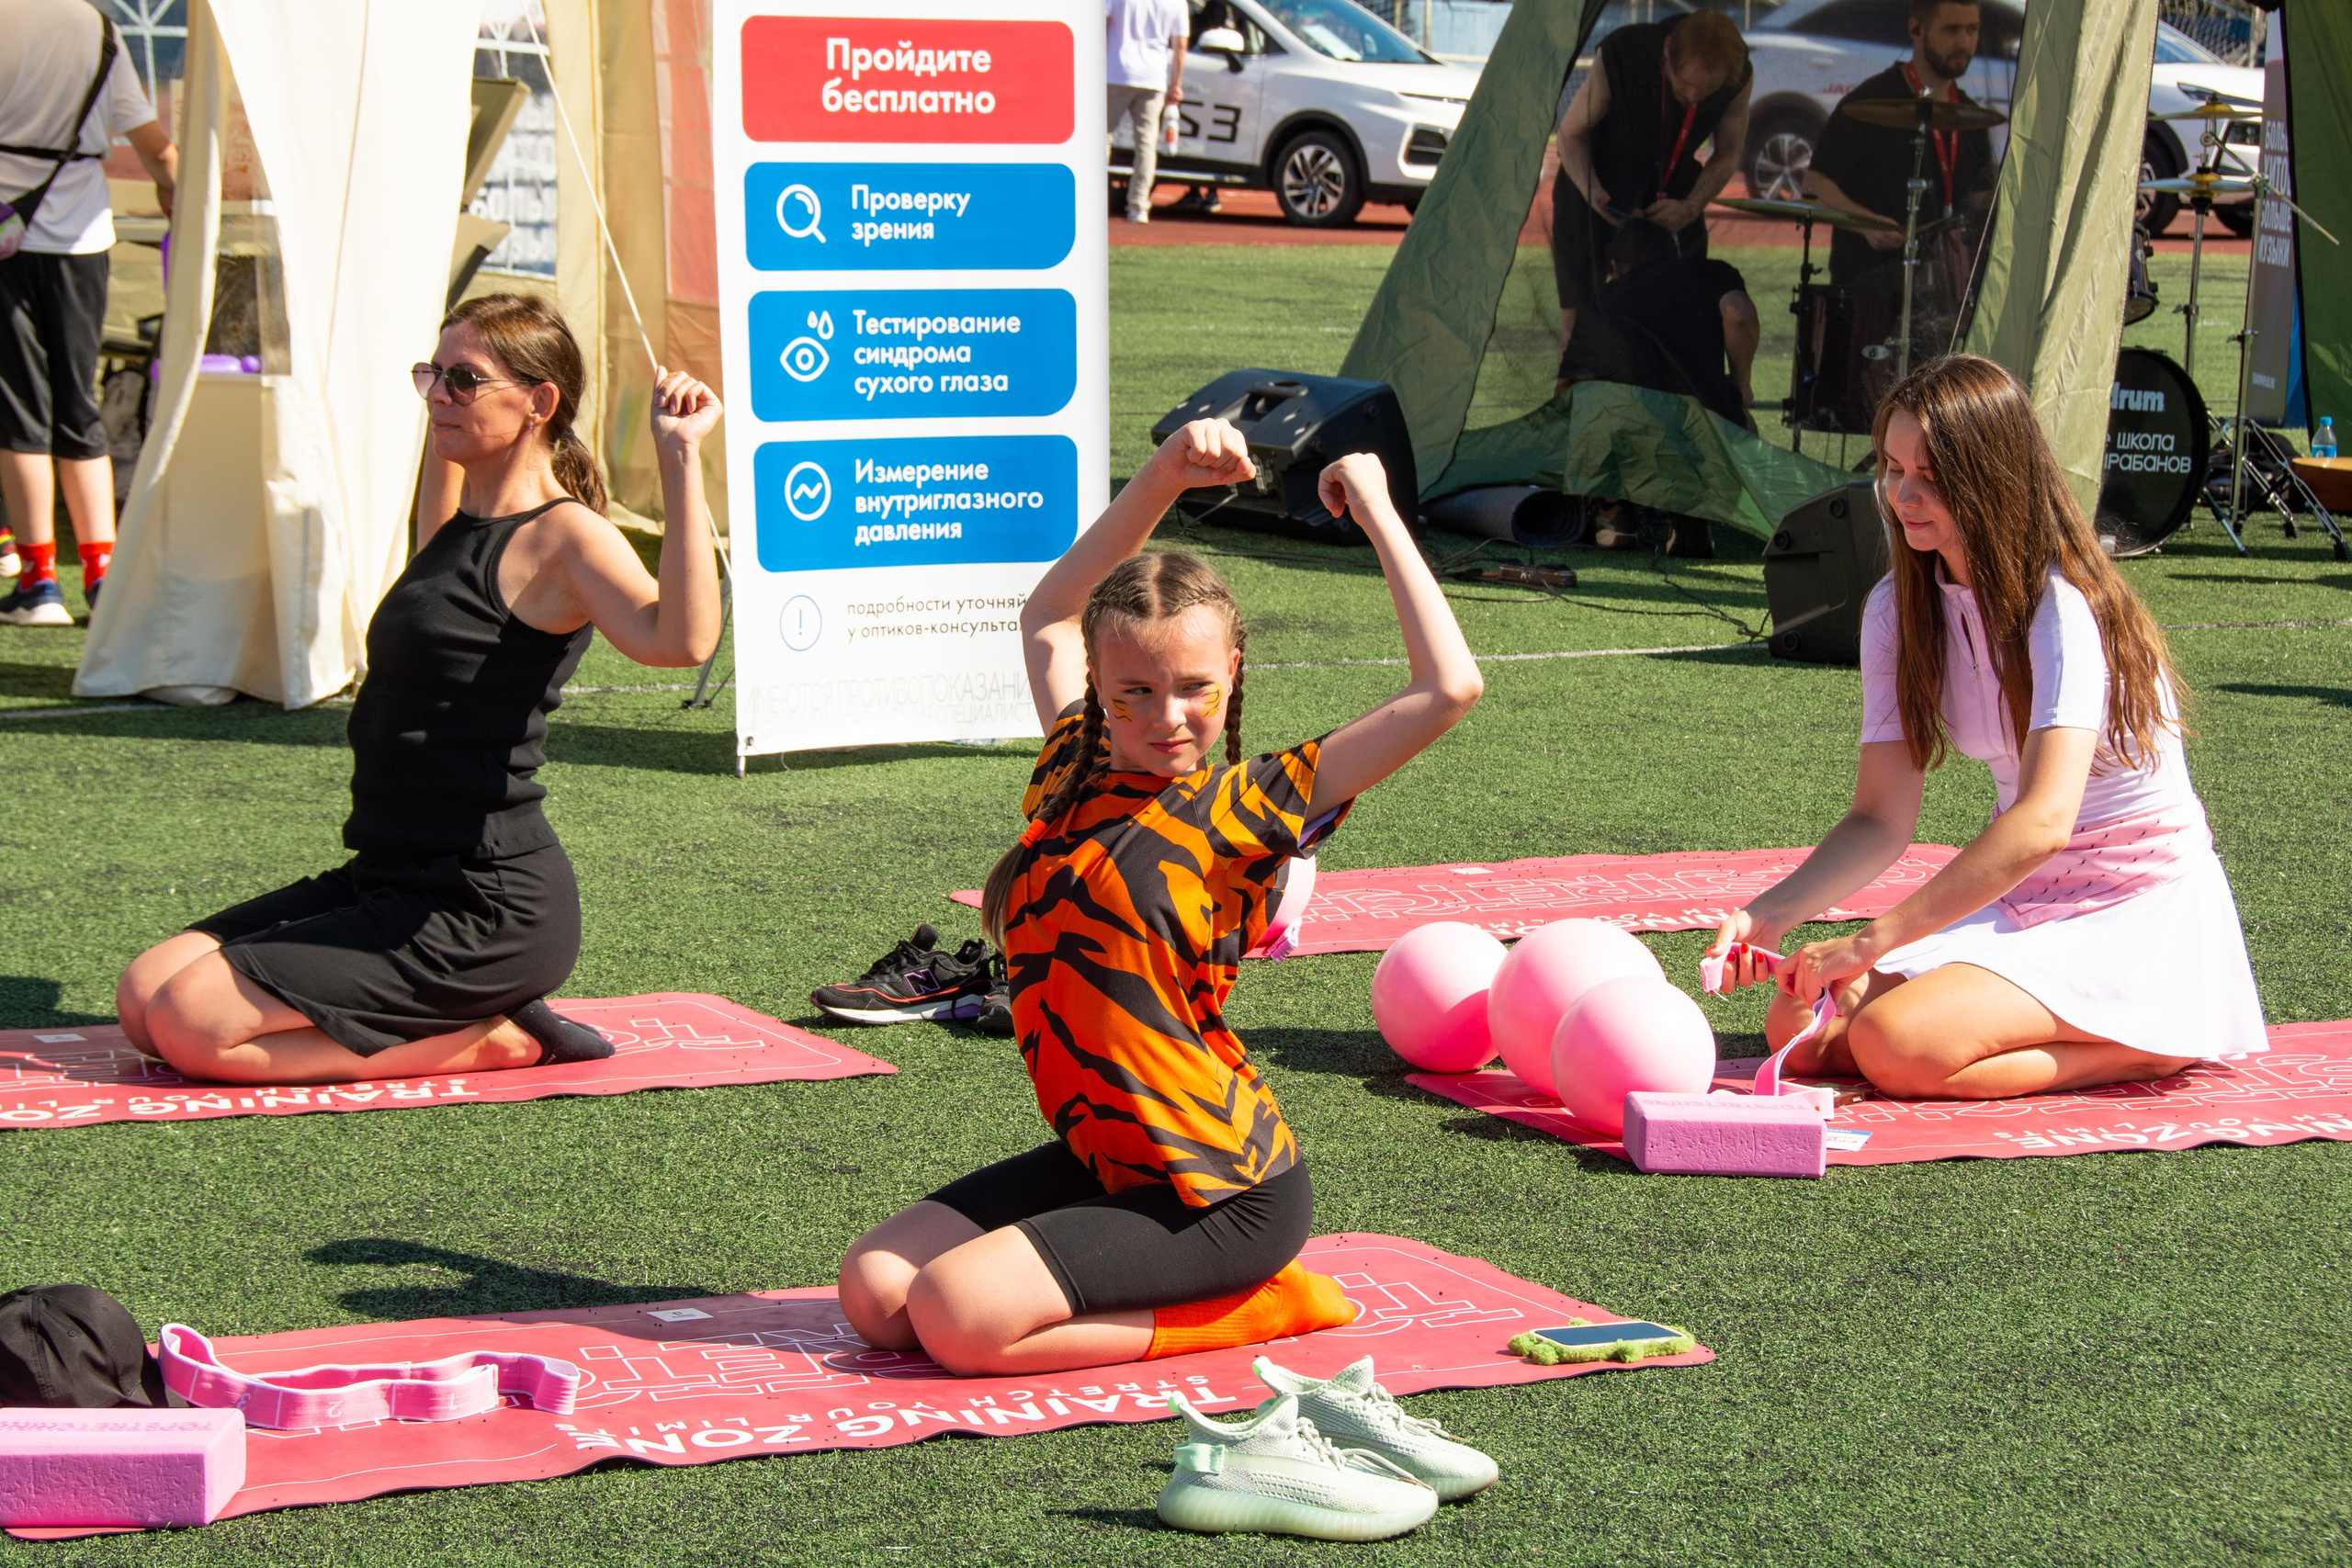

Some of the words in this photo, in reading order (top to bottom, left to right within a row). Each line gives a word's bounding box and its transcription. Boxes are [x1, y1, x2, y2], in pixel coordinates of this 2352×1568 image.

[826, 38, 992, 81] Пройдите
[821, 78, 996, 115] бесплатно
[2264, 119, 2289, 153] БОЛЬ
[851, 185, 971, 217] Проверку
[851, 219, 934, 246] зрения
[853, 310, 1021, 341] Тестирование
[854, 343, 972, 370] синдрома
[854, 376, 933, 401] сухого
[941, 373, 1009, 392] глаза
[854, 458, 989, 491] Измерение
[854, 489, 1045, 518] внутриглазного
[854, 520, 962, 547] давления
[847, 594, 951, 618] подробности
[847, 627, 855, 644] у
[861, 620, 1022, 638] оптиков-консульта
[743, 681, 833, 716] ИМЕЮТСЯ
[935, 702, 1036, 726] СПЕЦИАЛИСТ
[92, 1093, 223, 1105] YOUR
[129, 1084, 479, 1115] TRAINING
[255, 1078, 466, 1096] STRETCH
[1993, 1122, 2136, 1139] LIMITS
[2009, 1124, 2192, 1149] ZONE
[968, 1373, 1208, 1407] STRETCH
[326, 1400, 345, 1418] 2
[787, 1399, 928, 1421] YOUR
[833, 1381, 1237, 1438] TRAINING
[554, 1418, 749, 1437] LIMITS
[568, 1430, 811, 1454] ZONE
